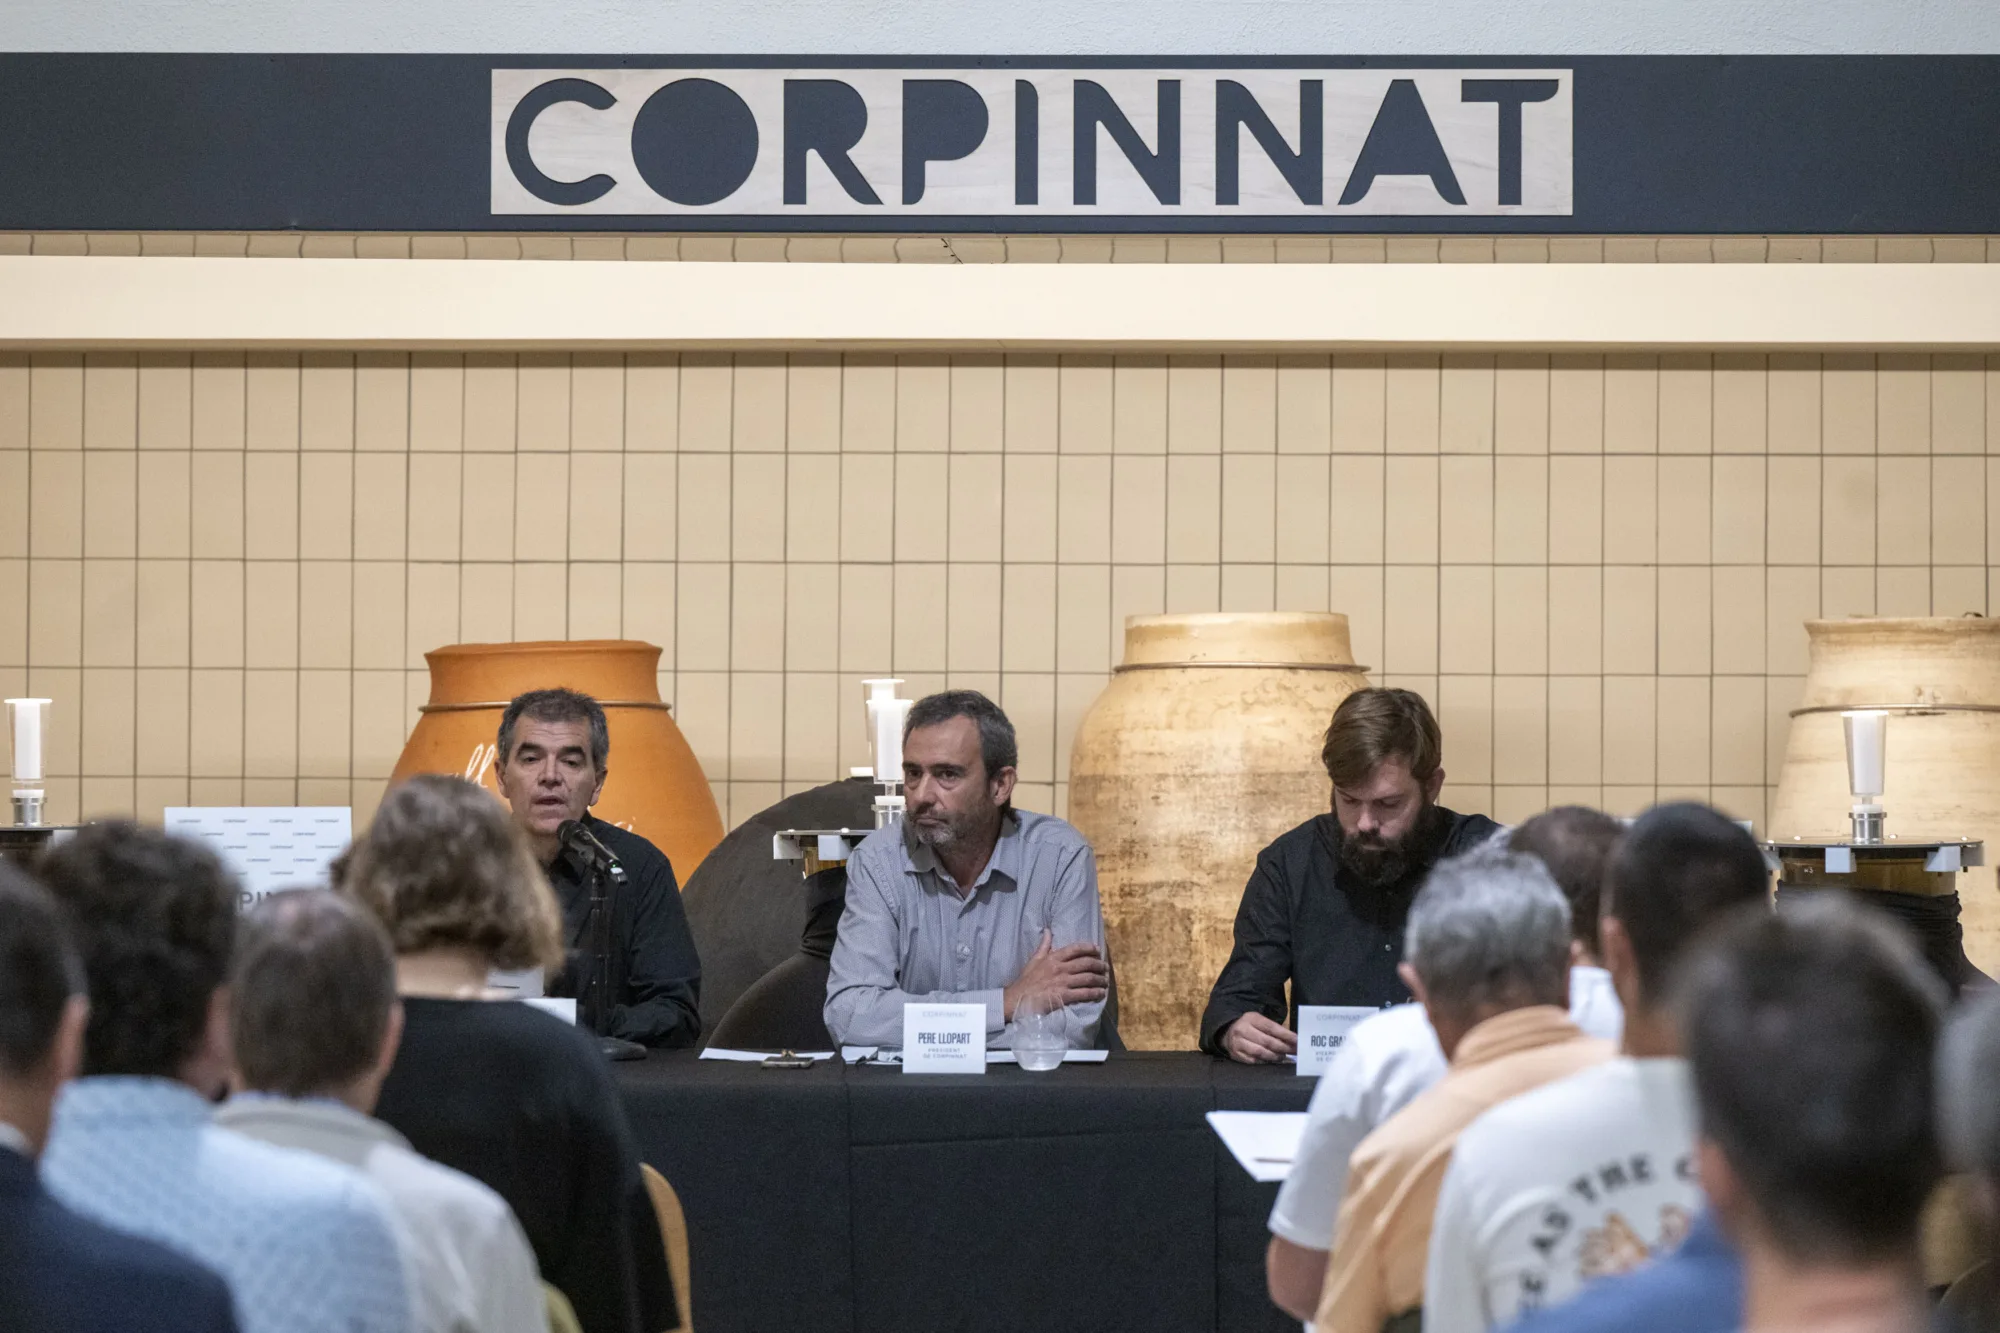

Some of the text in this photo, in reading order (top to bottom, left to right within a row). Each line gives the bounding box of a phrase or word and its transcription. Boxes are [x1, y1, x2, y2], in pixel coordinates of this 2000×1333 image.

[505, 78, 1560, 206] CORPINNAT
[918, 1032, 971, 1044] PERE LLOPART
[1311, 1035, 1327, 1047] ROC
[1569, 1154, 1653, 1204] THE
